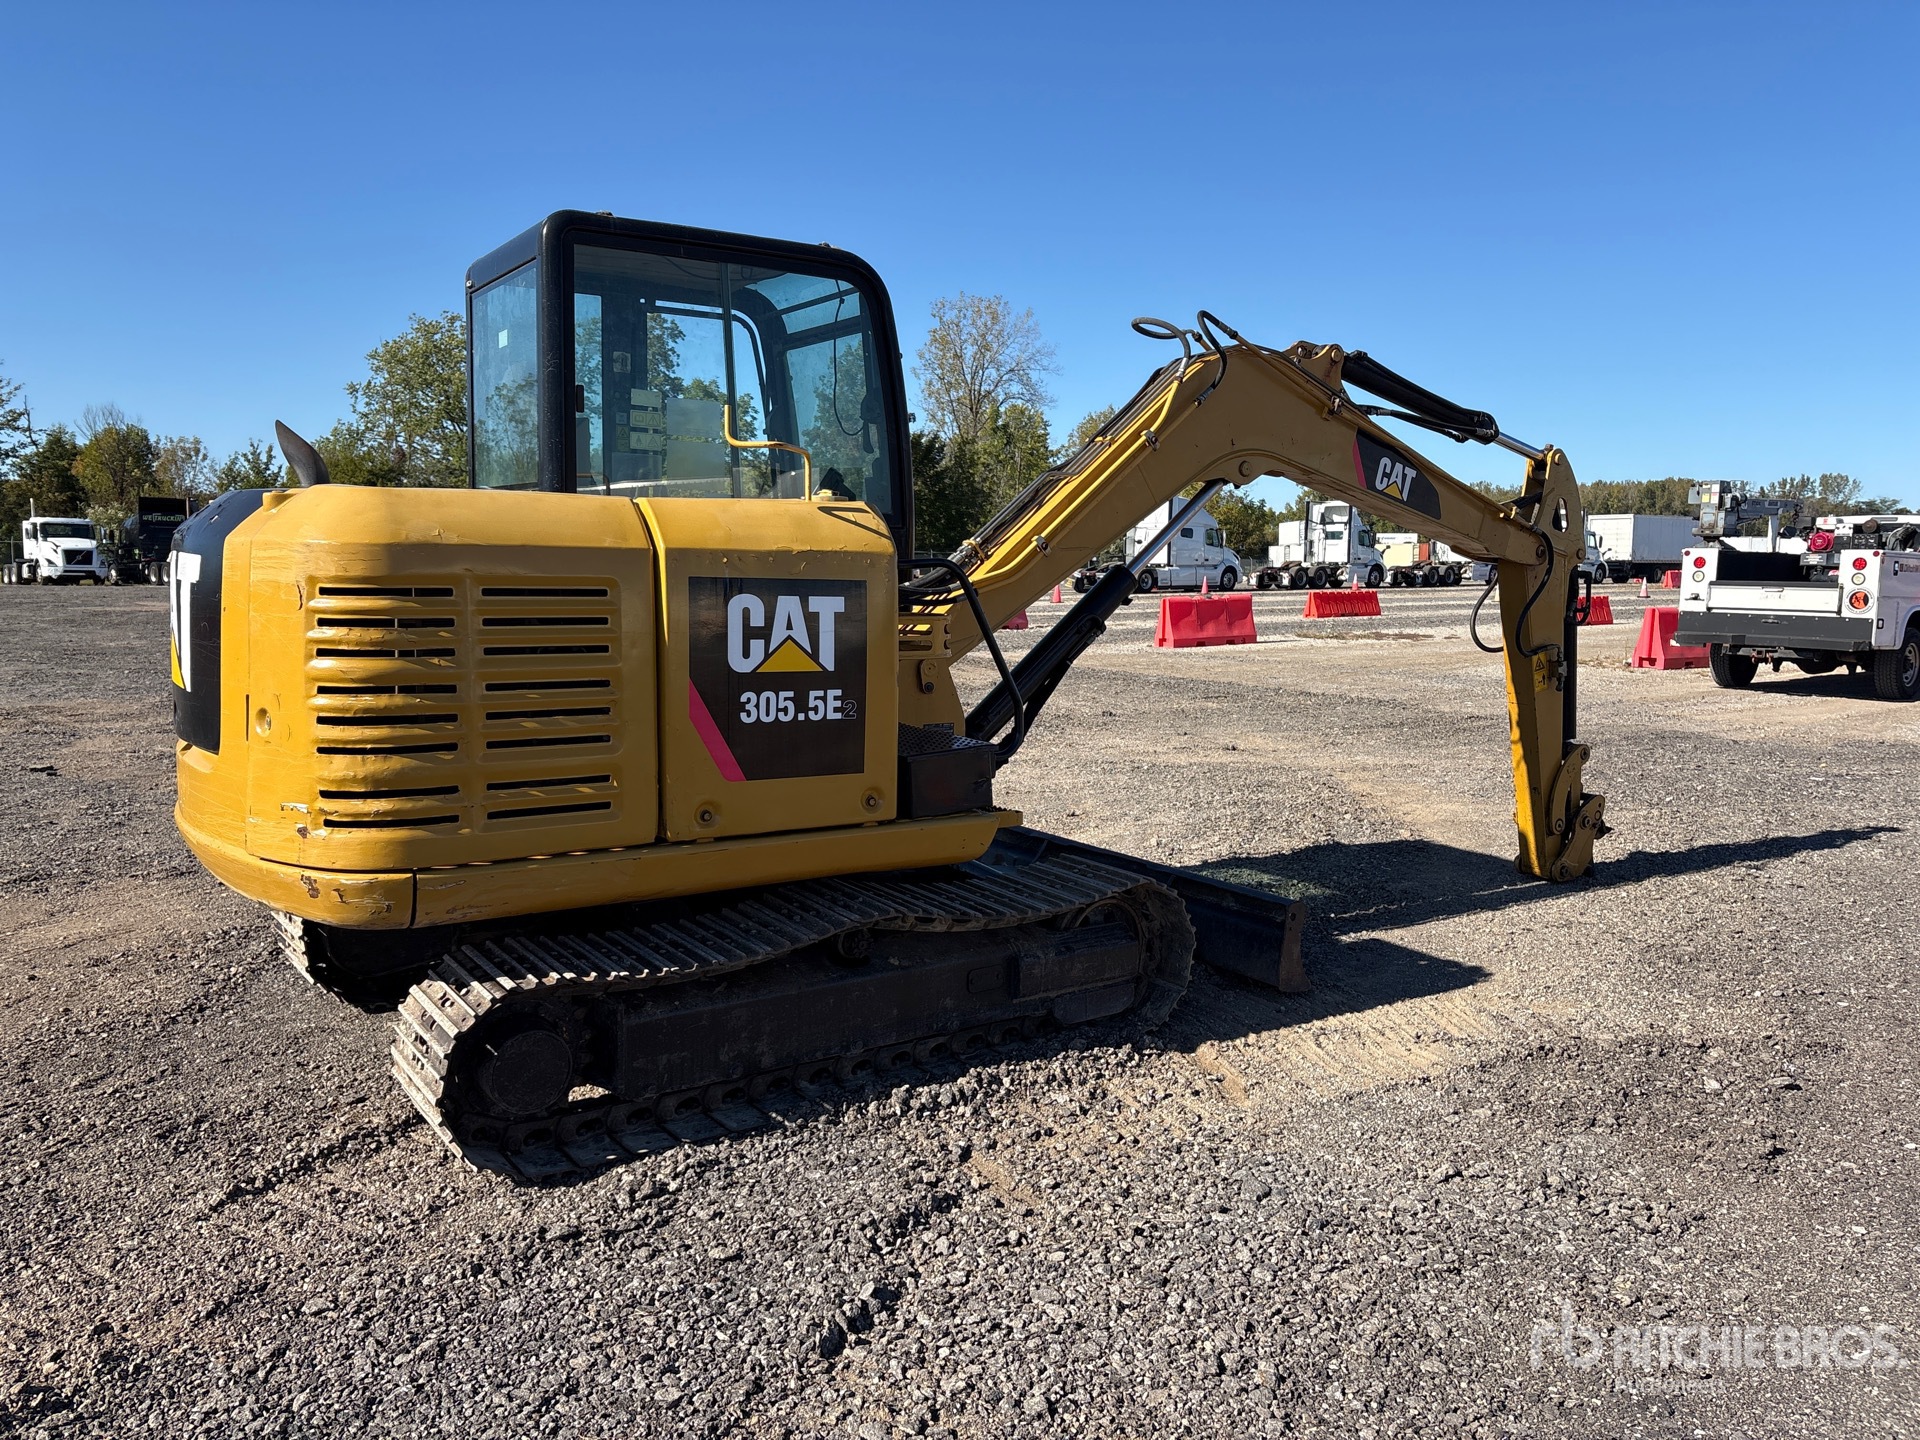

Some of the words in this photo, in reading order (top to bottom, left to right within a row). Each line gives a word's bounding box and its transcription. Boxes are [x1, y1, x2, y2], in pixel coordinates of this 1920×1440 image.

[1375, 457, 1417, 502] CAT
[727, 593, 845, 673] CAT
[740, 689, 857, 724] 305.5E2
